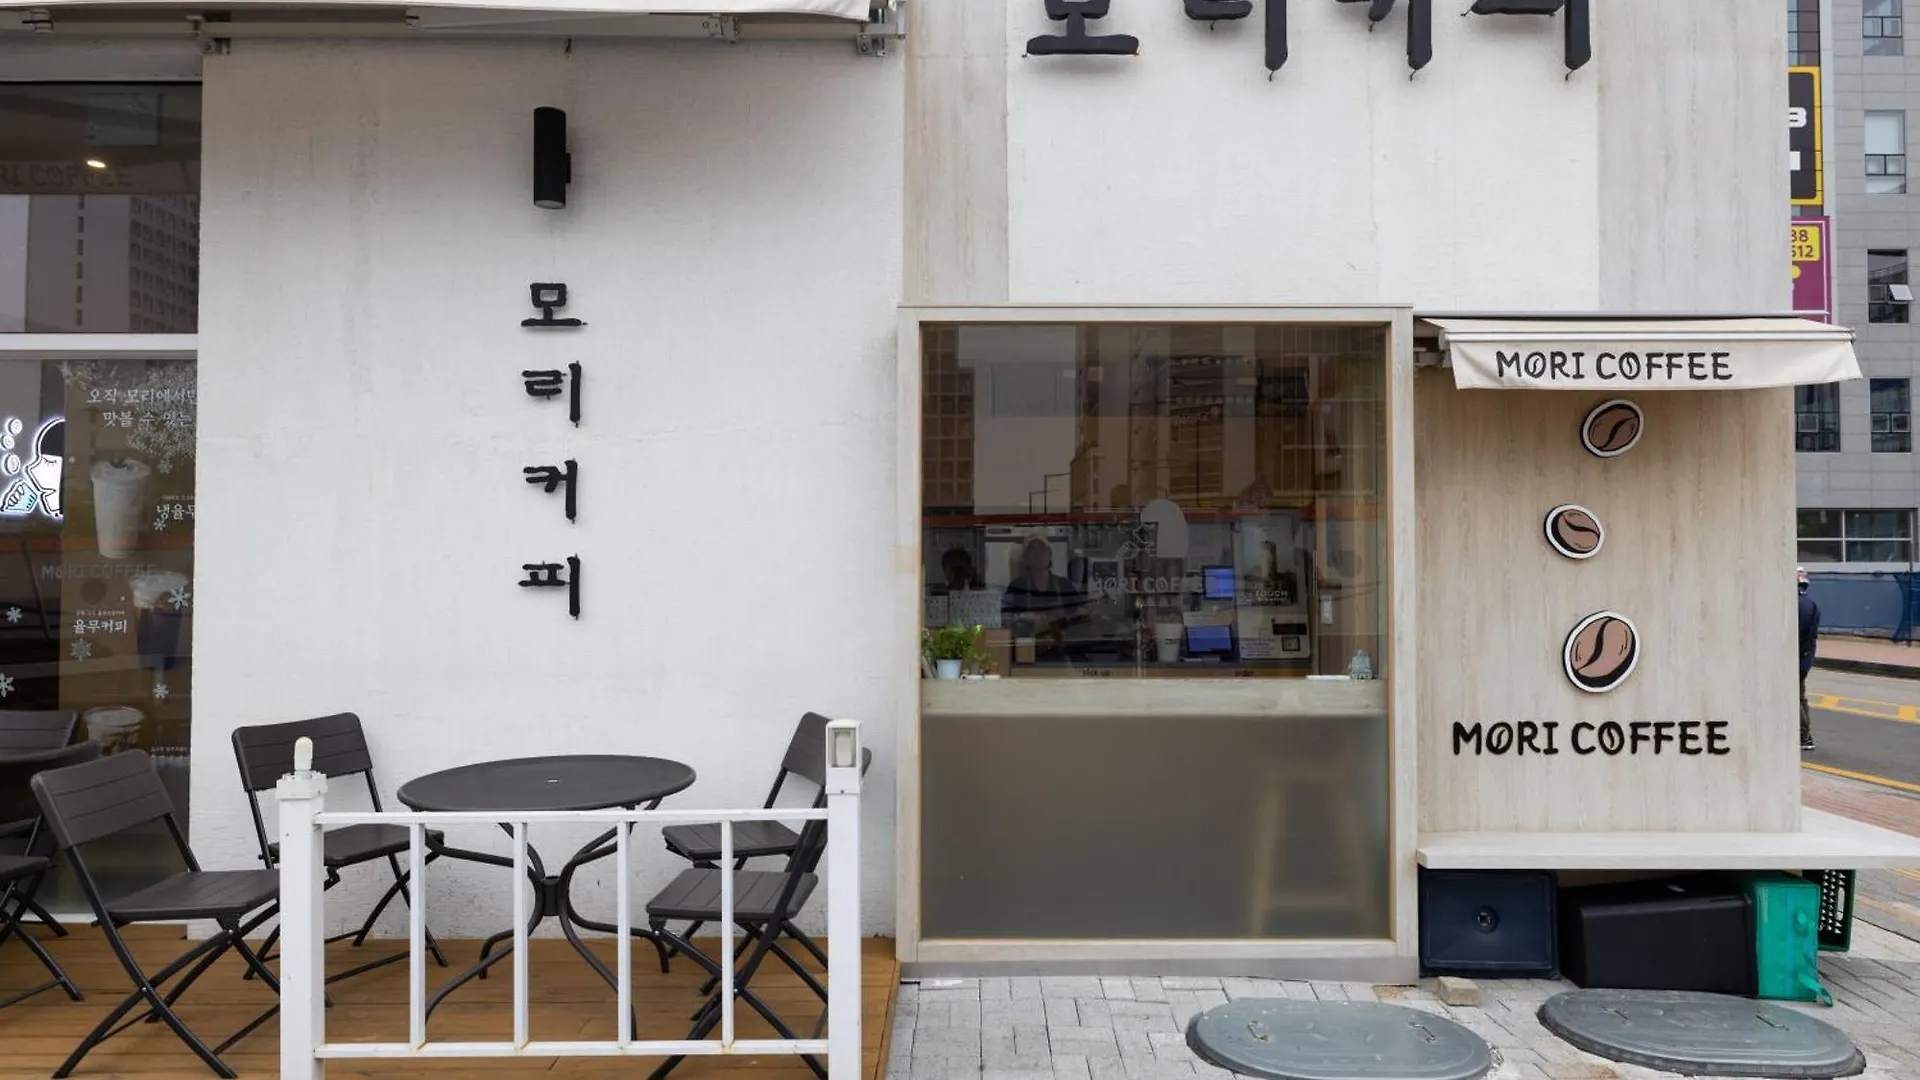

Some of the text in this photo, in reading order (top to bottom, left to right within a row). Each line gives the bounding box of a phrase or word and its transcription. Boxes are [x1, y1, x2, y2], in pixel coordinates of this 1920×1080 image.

[1496, 350, 1733, 380] MORI COFFEE
[85, 388, 118, 405] 오직
[518, 281, 584, 619] 모리커피
[73, 618, 127, 634] 율무커피
[1453, 720, 1731, 756] MORI COFFEE
